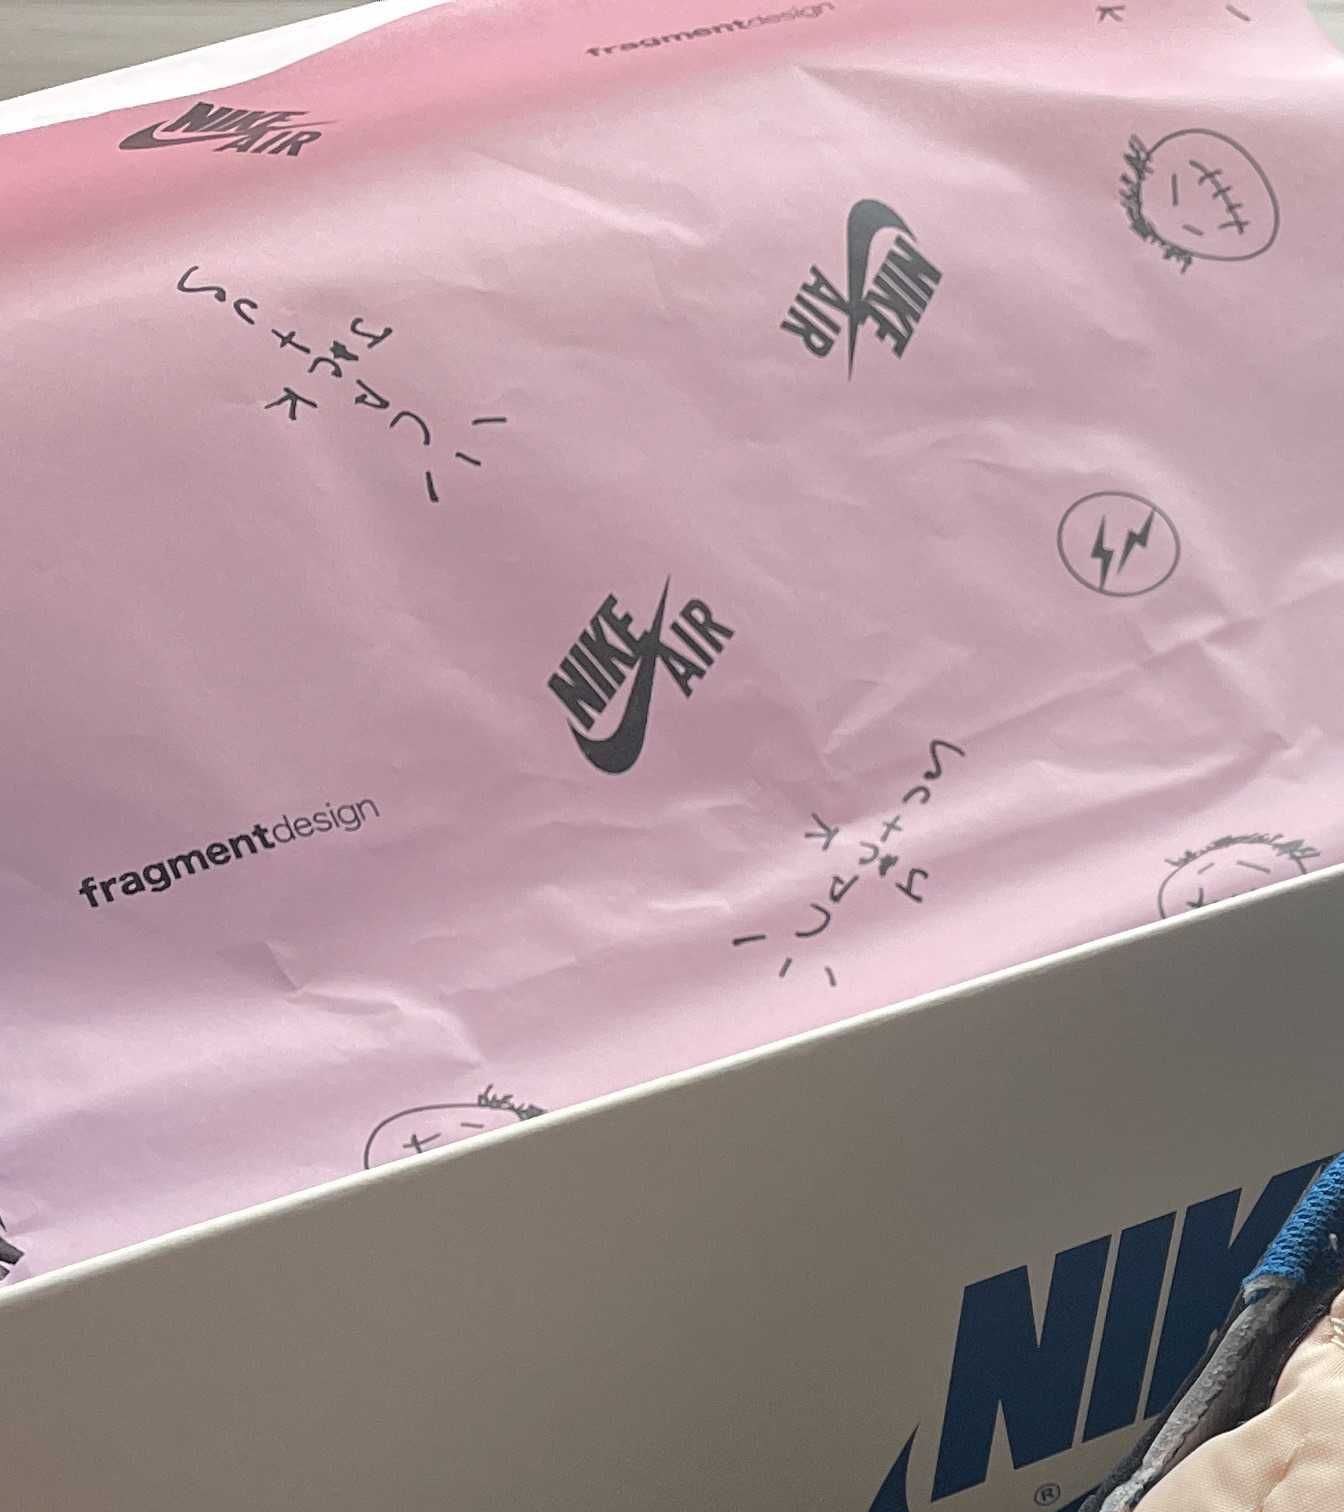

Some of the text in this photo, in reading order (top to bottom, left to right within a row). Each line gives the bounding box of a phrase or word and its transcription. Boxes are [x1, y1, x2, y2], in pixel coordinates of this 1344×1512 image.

[587, 1, 834, 56] fragmentdesign
[162, 101, 310, 132] NIKE
[212, 130, 322, 157] AIR
[780, 264, 850, 359] AIR
[863, 235, 943, 360] NIKE
[548, 593, 650, 732] NIKE
[659, 598, 735, 699] AIR
[79, 798, 380, 908] fragmentdesign
